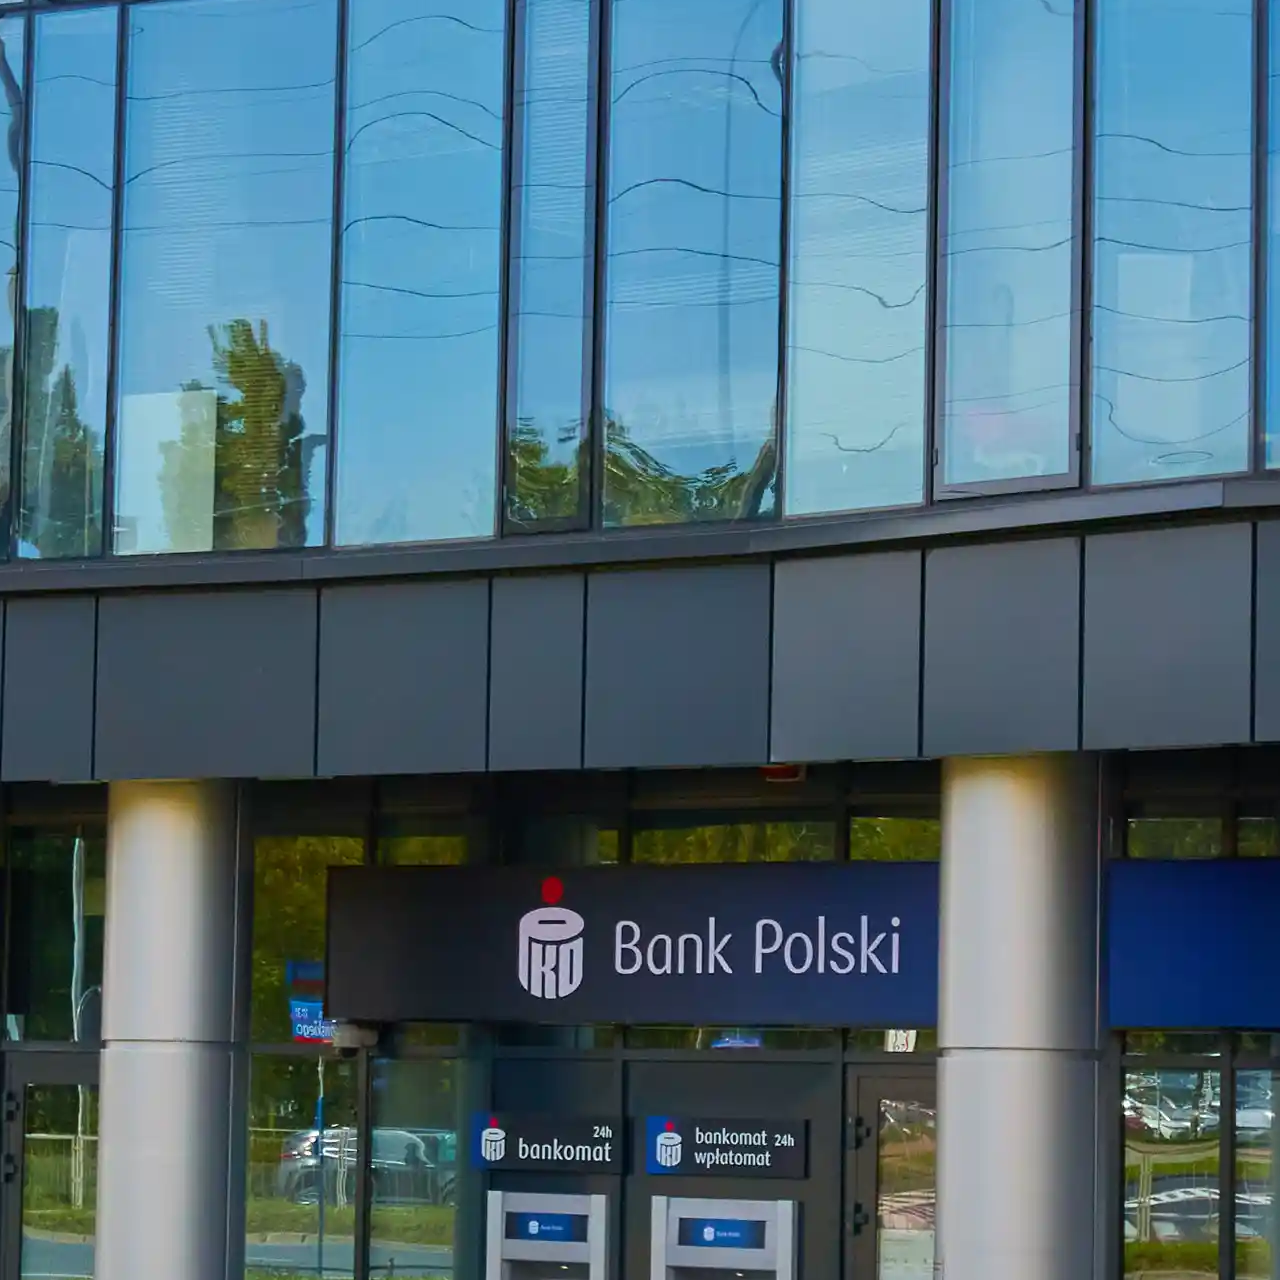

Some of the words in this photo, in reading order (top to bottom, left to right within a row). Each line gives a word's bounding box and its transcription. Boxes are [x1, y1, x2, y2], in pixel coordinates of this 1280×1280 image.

[615, 917, 733, 975] Bank
[755, 915, 901, 974] Polski
[593, 1126, 613, 1139] 24h
[695, 1127, 768, 1146] bankomat
[774, 1134, 795, 1147] 24h
[518, 1137, 612, 1162] bankomat
[694, 1148, 772, 1169] wpłatomat
